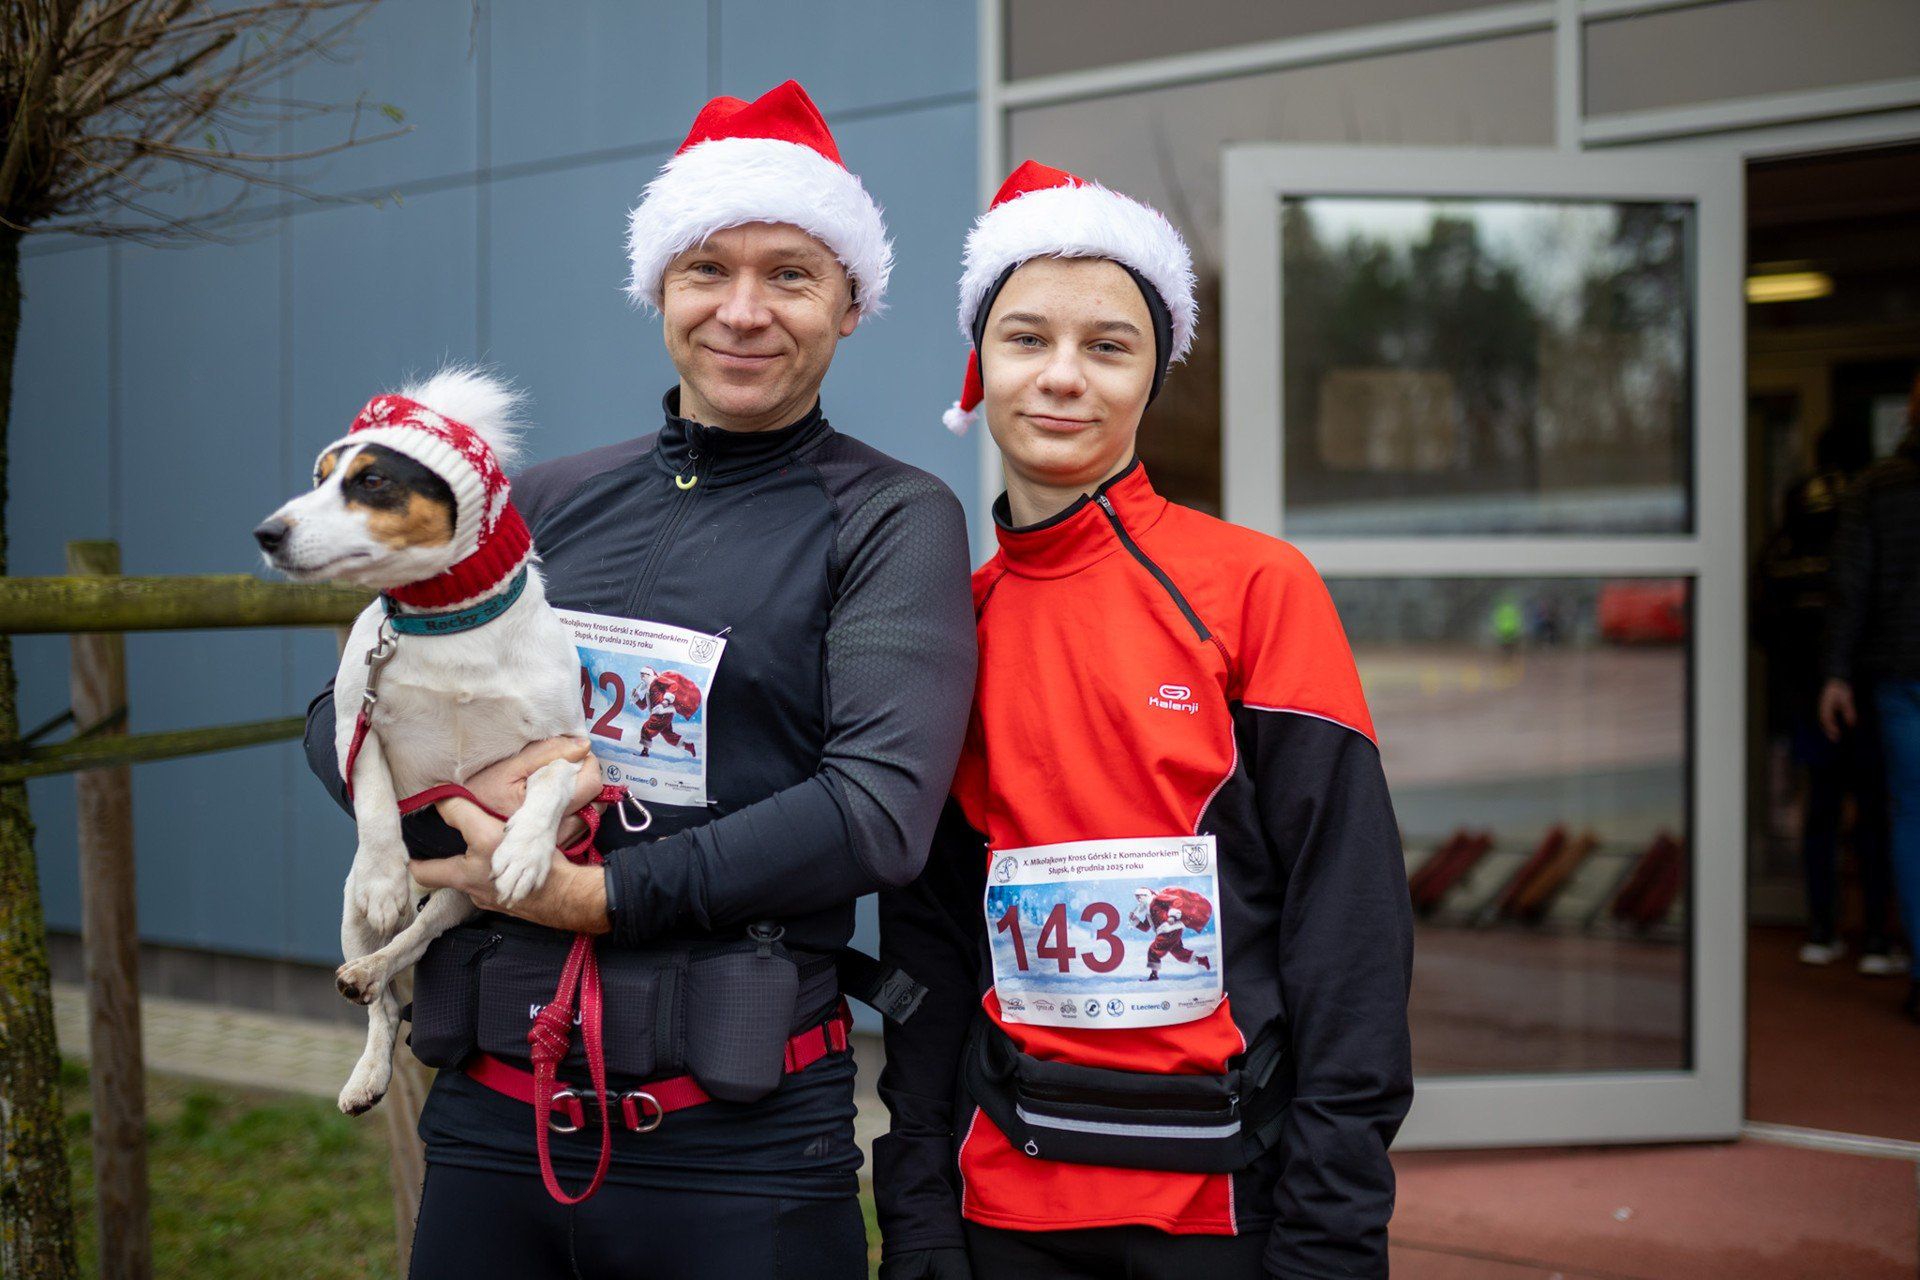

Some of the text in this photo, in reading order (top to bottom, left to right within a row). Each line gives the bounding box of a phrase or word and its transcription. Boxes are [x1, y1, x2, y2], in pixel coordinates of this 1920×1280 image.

[592, 623, 608, 632] Kross
[609, 625, 629, 635] Górski
[634, 629, 689, 645] Komandorkiem
[598, 635, 622, 646] grudnia
[622, 638, 637, 648] 2025
[637, 641, 653, 650] roku
[1030, 855, 1067, 867] Mikołajkowy
[1068, 853, 1087, 863] Kross
[1087, 851, 1112, 861] Górski
[1118, 849, 1180, 859] Komandorkiem
[1070, 864, 1076, 872] 6
[1076, 863, 1105, 875] grudnia
[1106, 862, 1124, 871] 2025
[1125, 862, 1144, 871] roku
[996, 902, 1125, 973] 143
